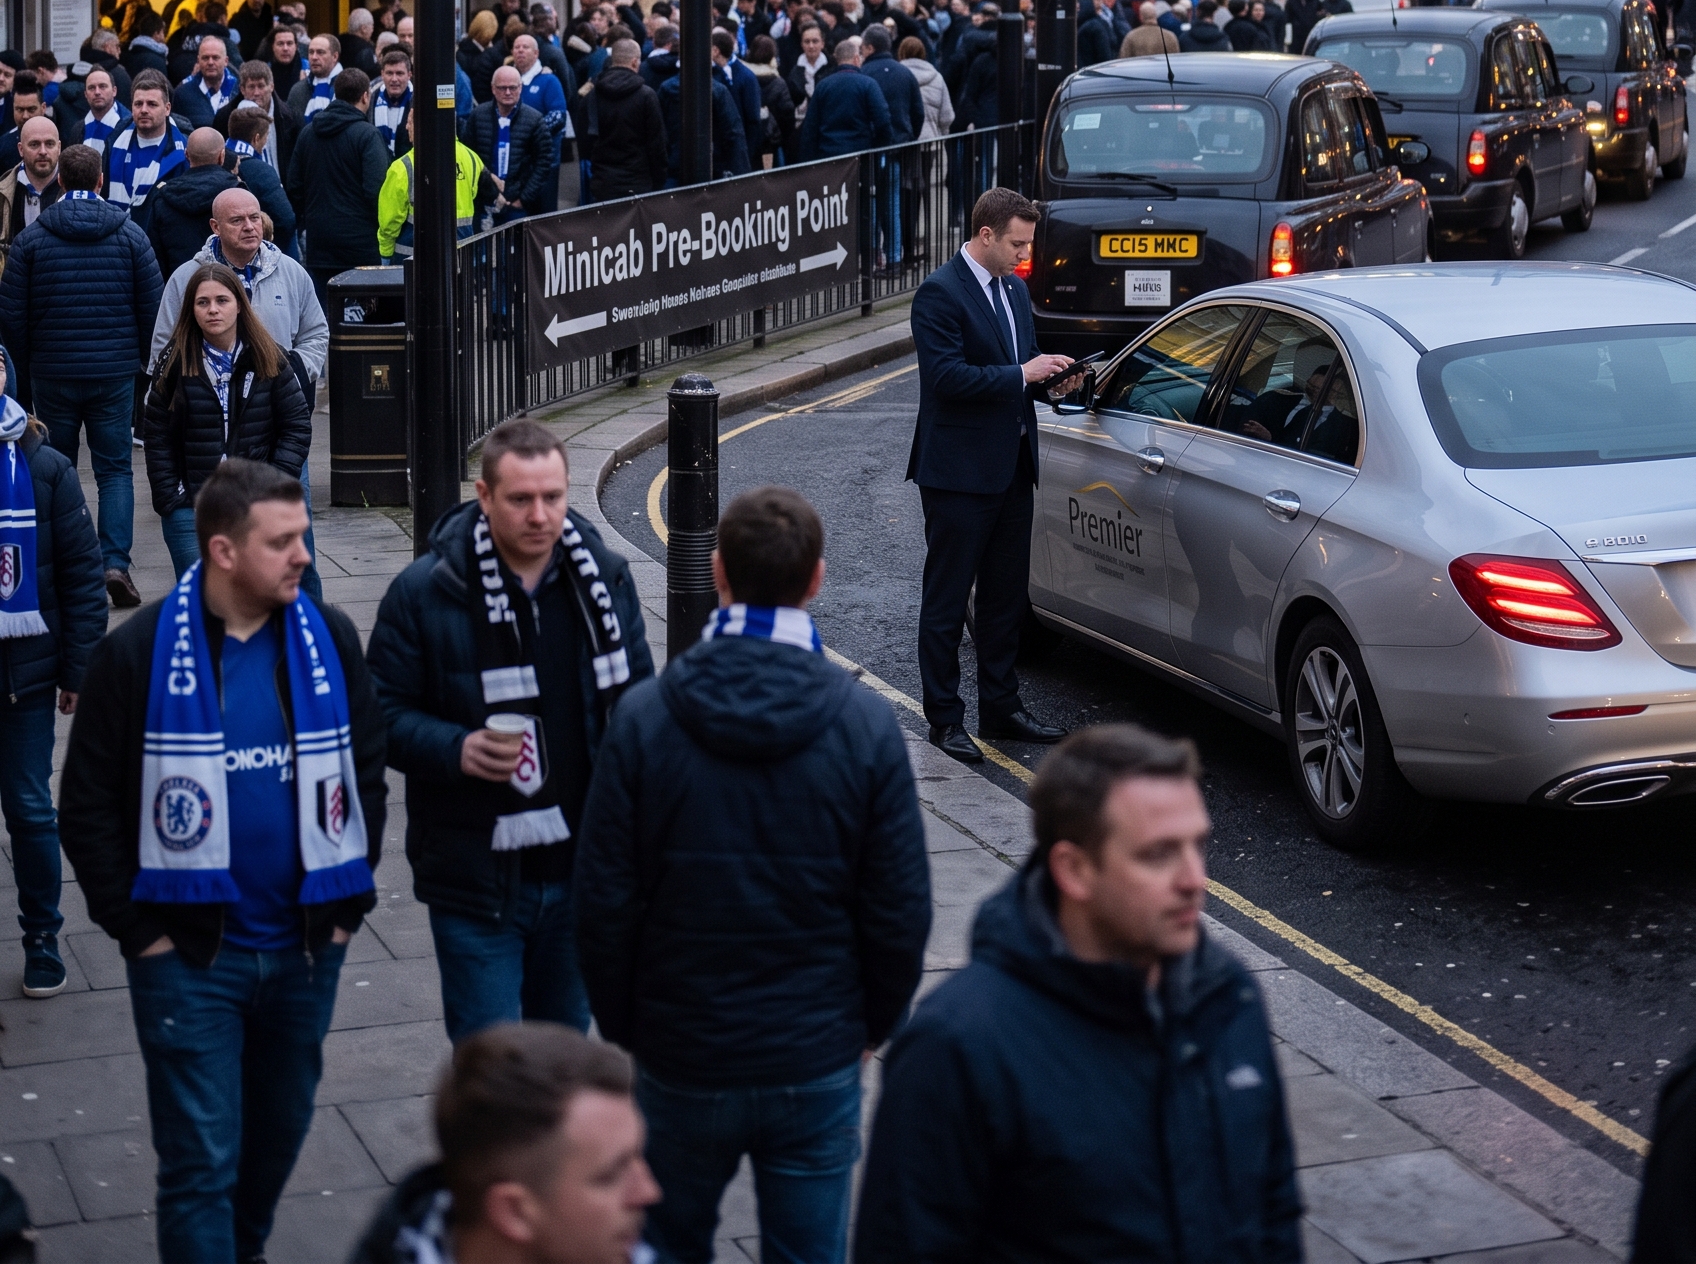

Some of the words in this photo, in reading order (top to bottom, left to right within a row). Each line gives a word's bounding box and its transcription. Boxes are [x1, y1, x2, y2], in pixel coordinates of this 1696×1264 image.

[543, 228, 644, 299] Minicab
[651, 200, 790, 272] Pre-Booking
[796, 182, 849, 237] Point
[1108, 237, 1149, 254] CC15
[1068, 496, 1143, 558] Premier
